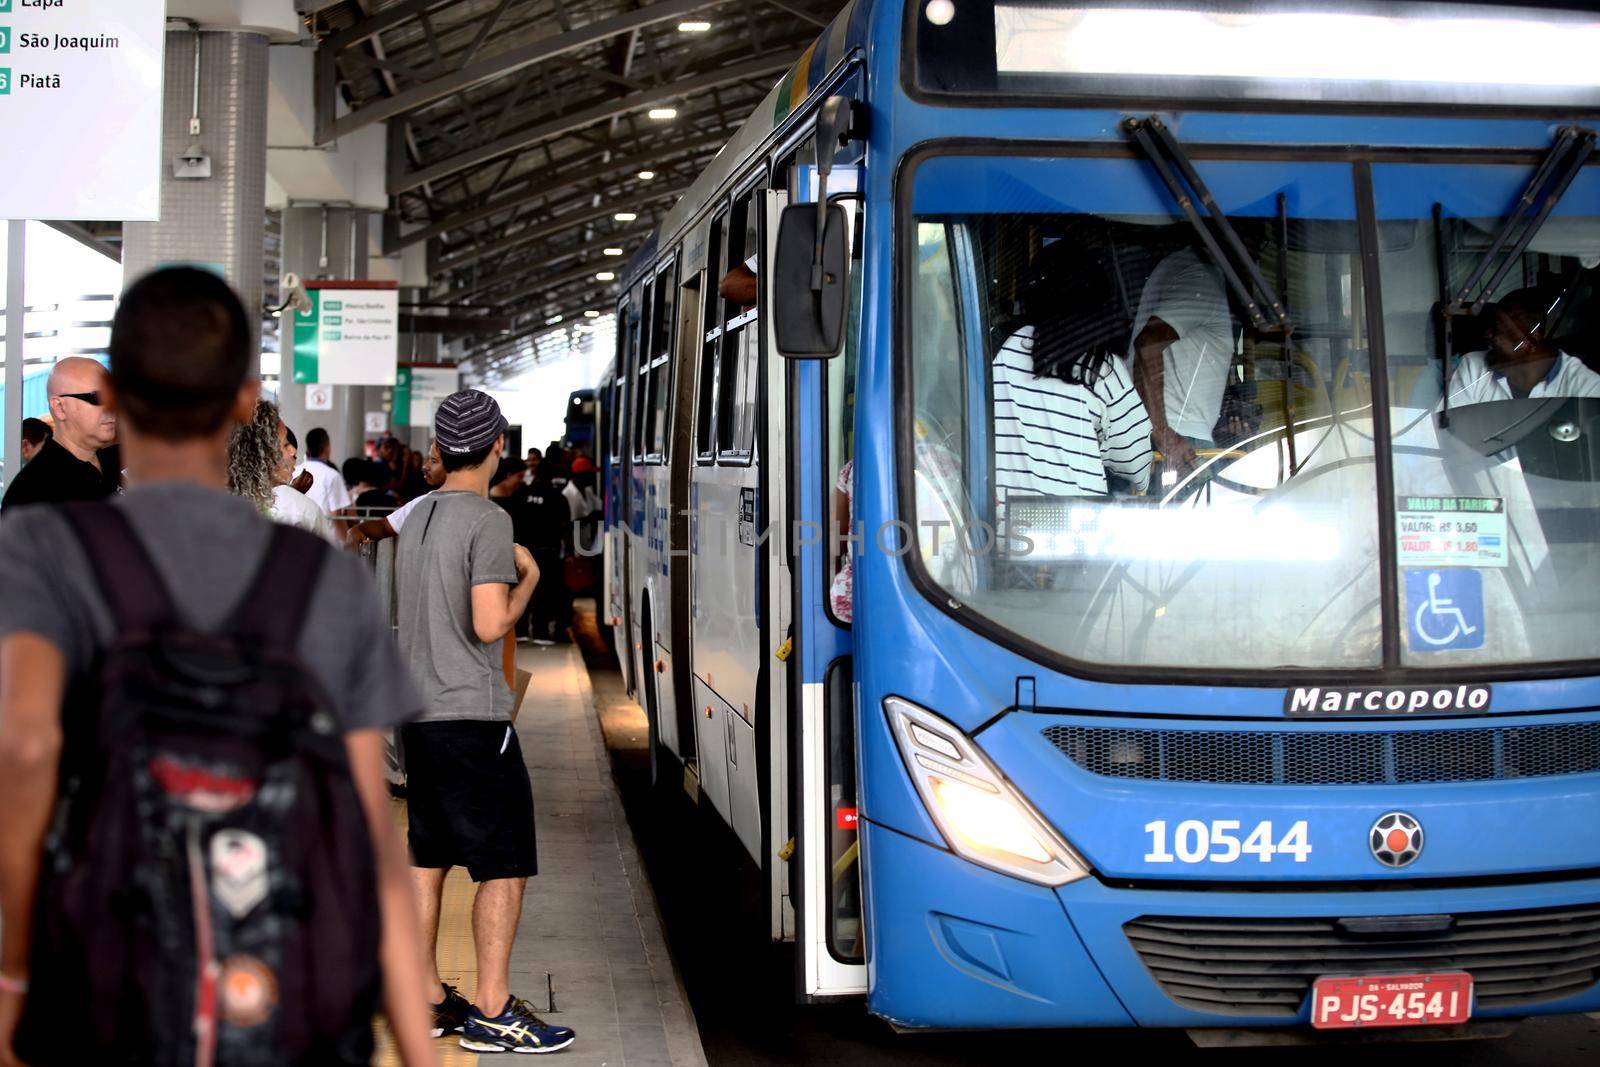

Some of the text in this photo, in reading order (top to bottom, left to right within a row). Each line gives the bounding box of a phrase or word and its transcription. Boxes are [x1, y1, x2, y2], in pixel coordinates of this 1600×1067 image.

[20, 33, 49, 48] São
[54, 33, 119, 51] Joaquim
[20, 73, 61, 88] Piatã
[1290, 685, 1489, 712] Marcopolo
[1144, 820, 1313, 863] 10544
